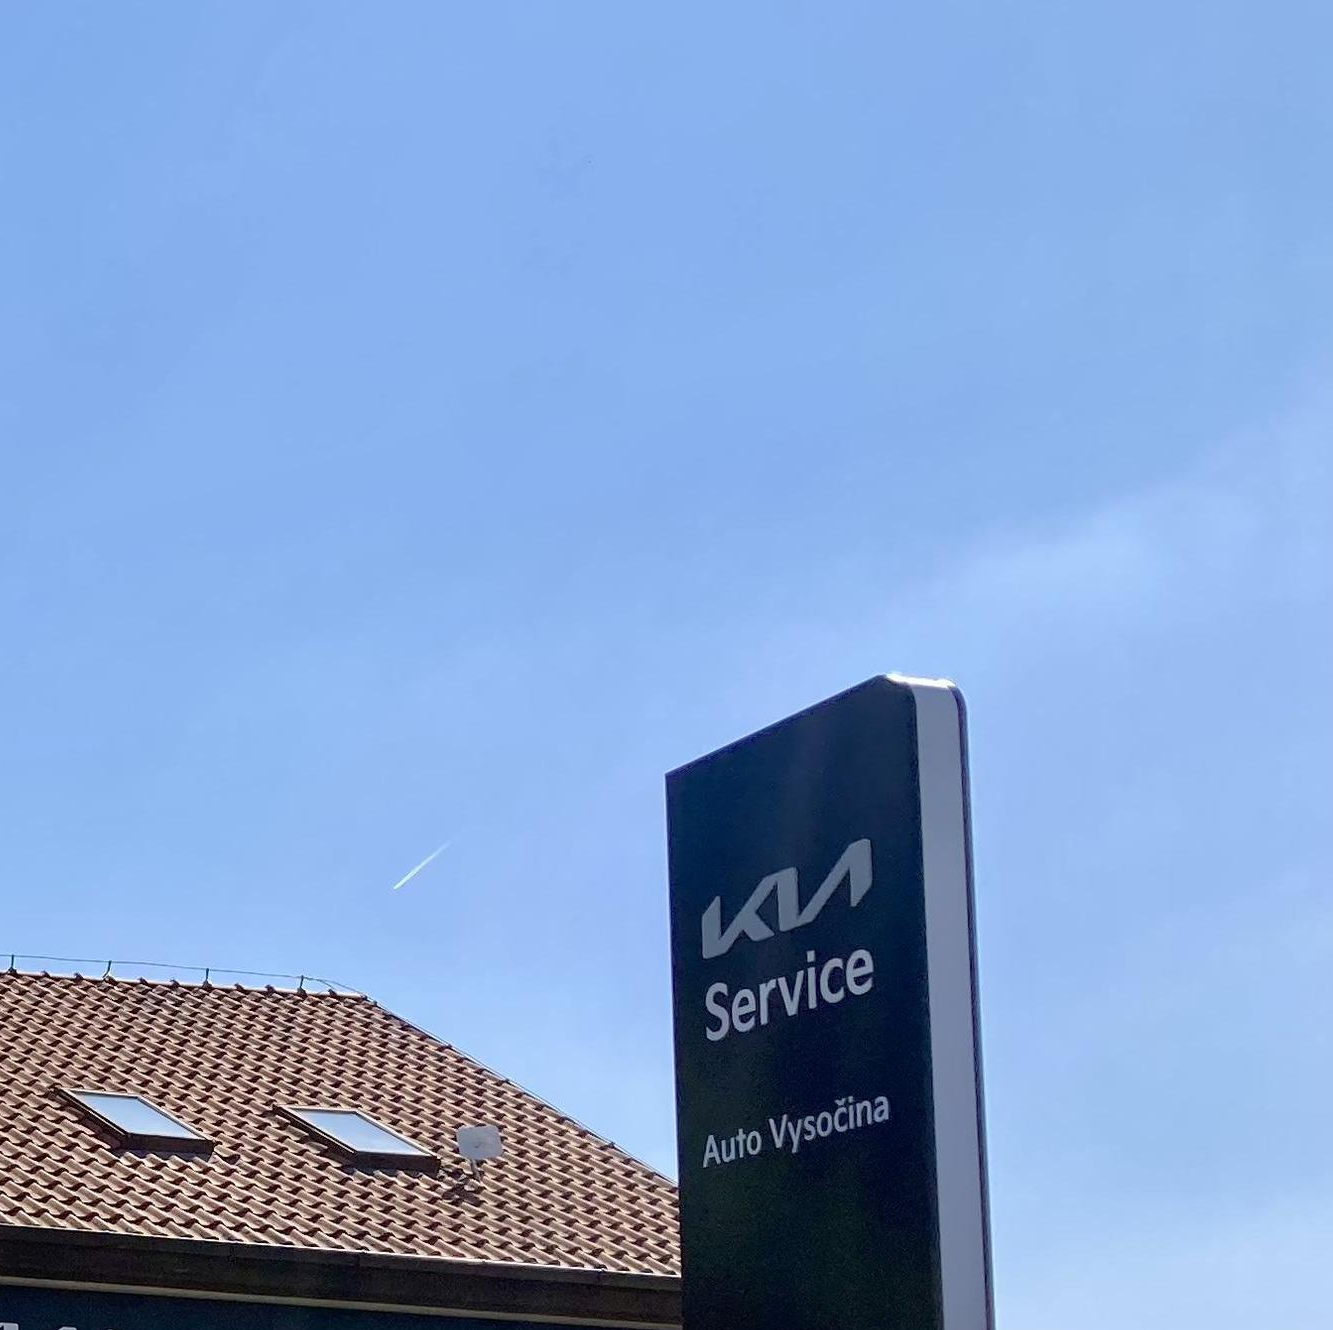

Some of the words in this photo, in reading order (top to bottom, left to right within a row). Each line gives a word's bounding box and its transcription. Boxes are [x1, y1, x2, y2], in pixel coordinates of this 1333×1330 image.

[705, 948, 875, 1042] Service
[702, 1127, 763, 1169] Auto
[767, 1095, 891, 1154] Vysočina
